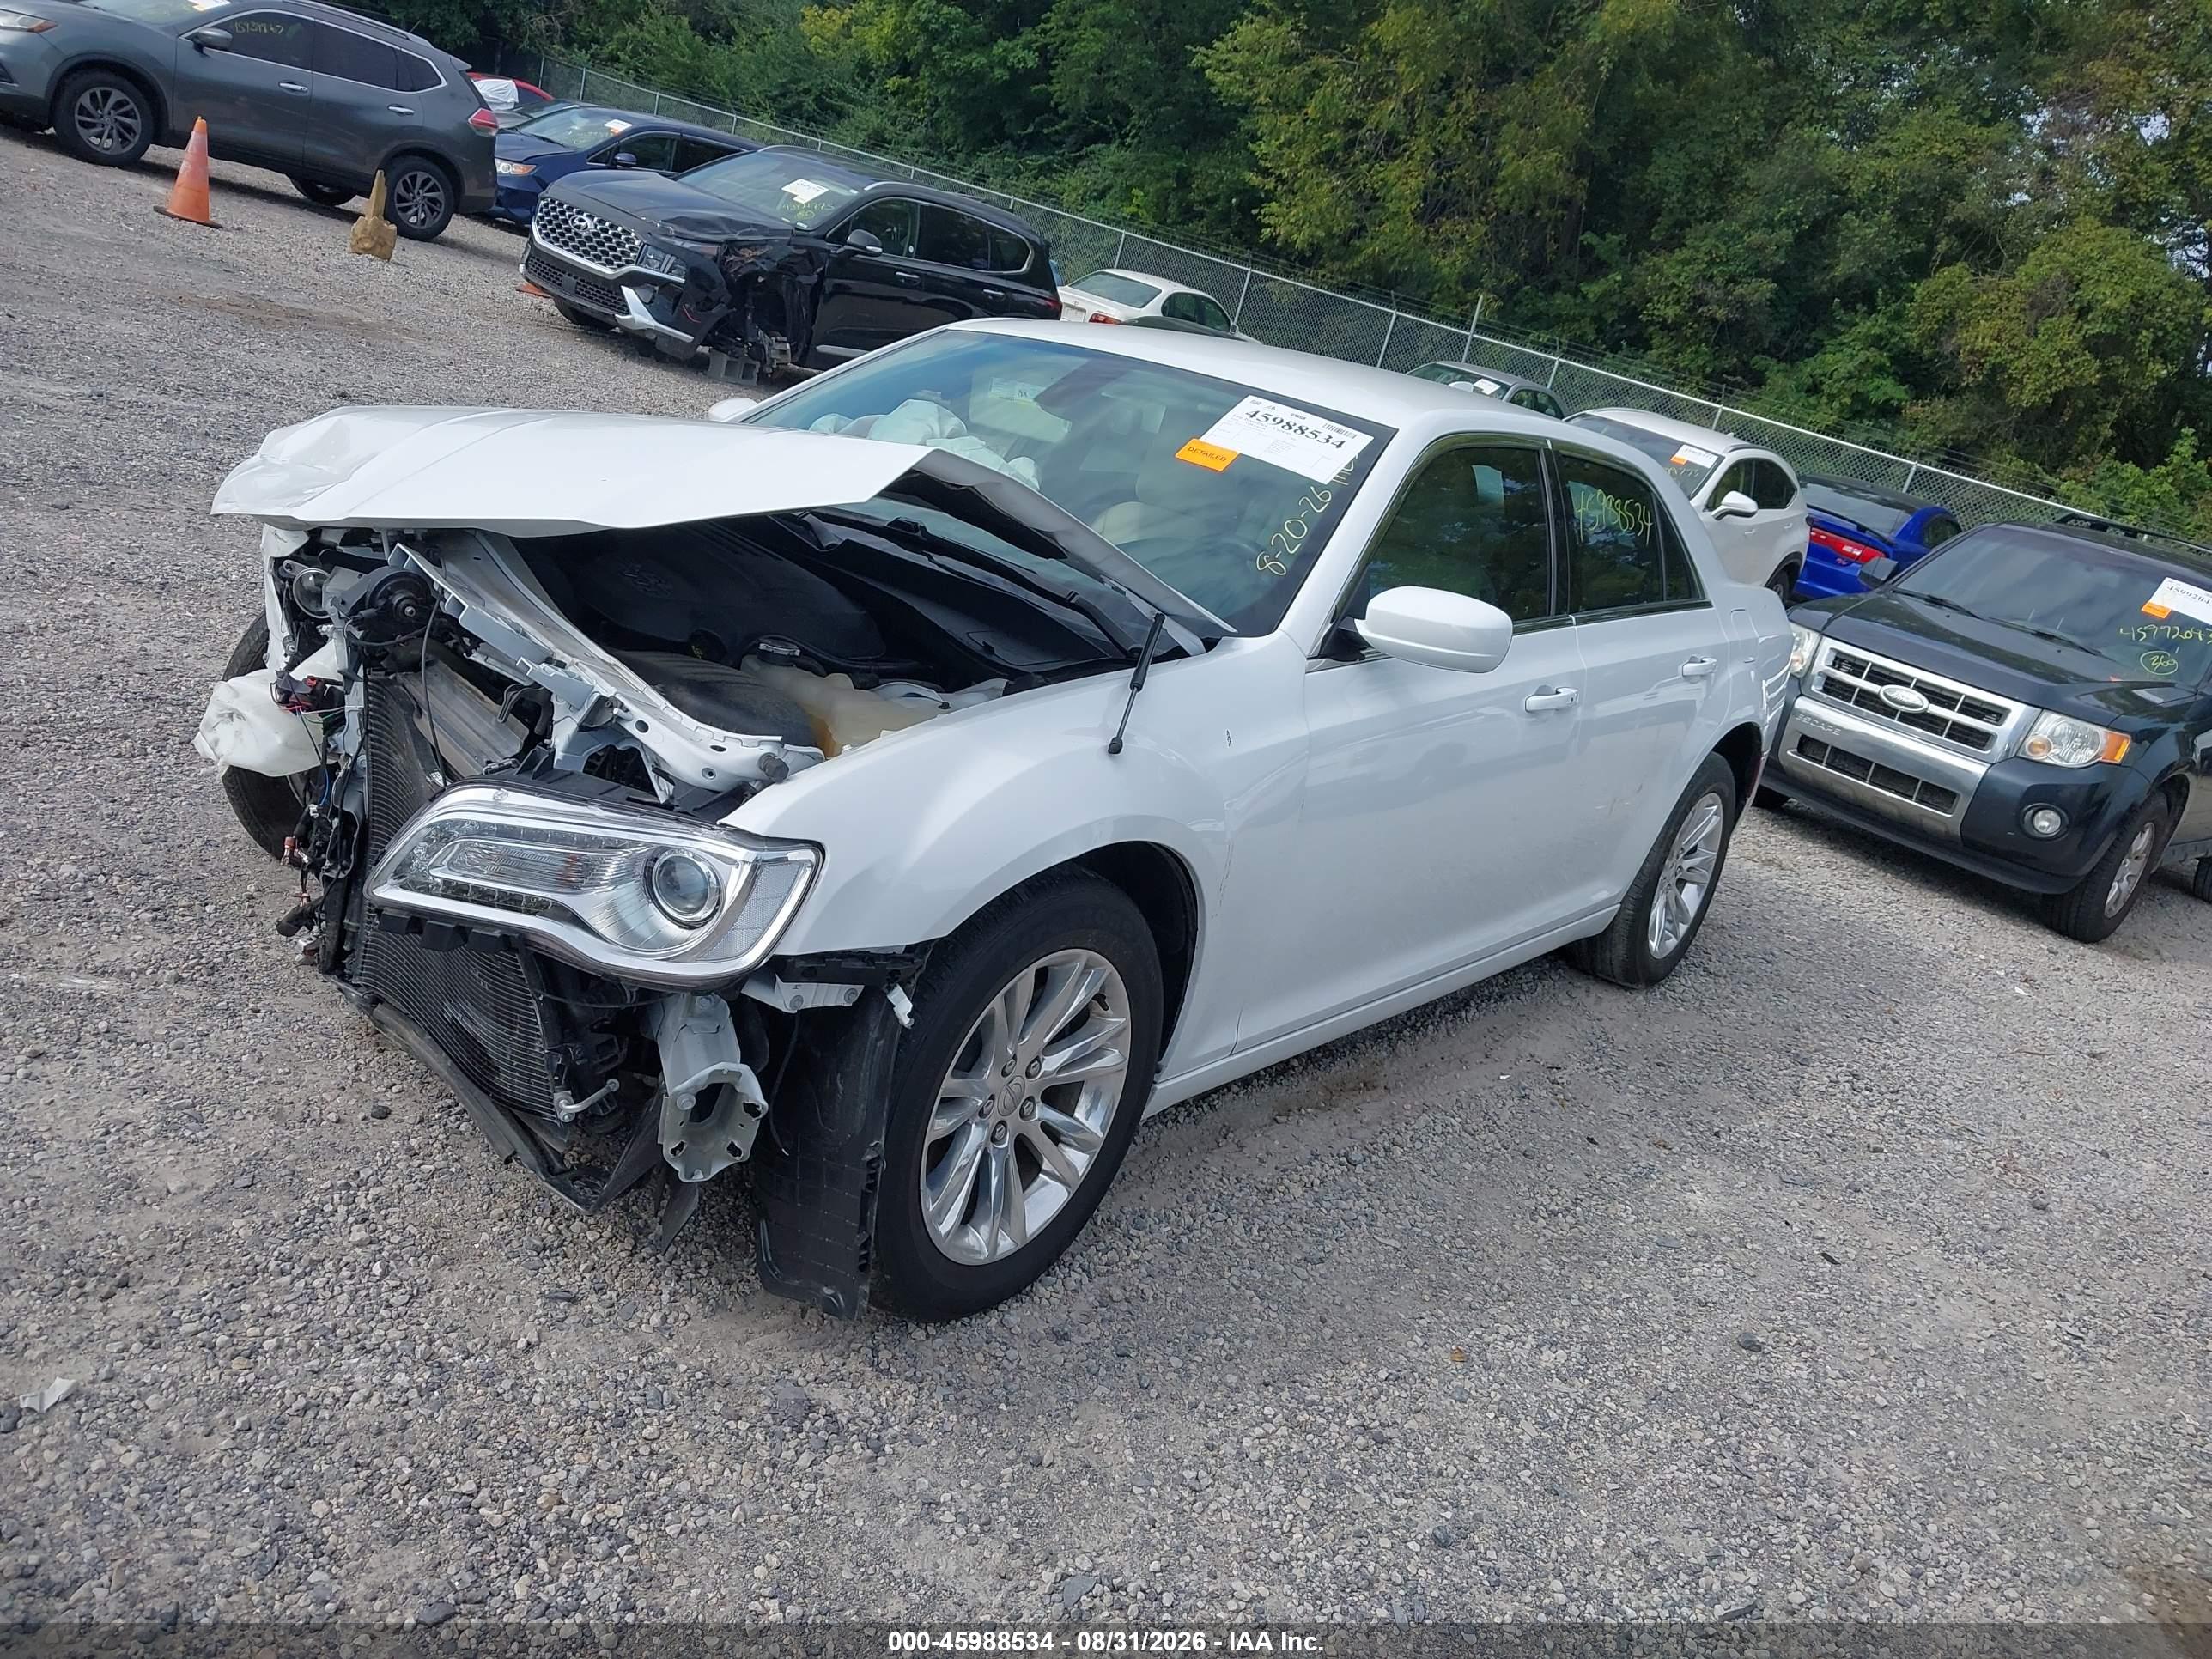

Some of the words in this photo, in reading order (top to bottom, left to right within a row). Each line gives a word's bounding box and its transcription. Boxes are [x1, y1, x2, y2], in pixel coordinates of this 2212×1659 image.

[1245, 410, 1346, 449] 45988534
[1188, 445, 1227, 463] DETAILED
[1256, 486, 1332, 576] 8-20-26
[1575, 489, 1654, 547] 45988534
